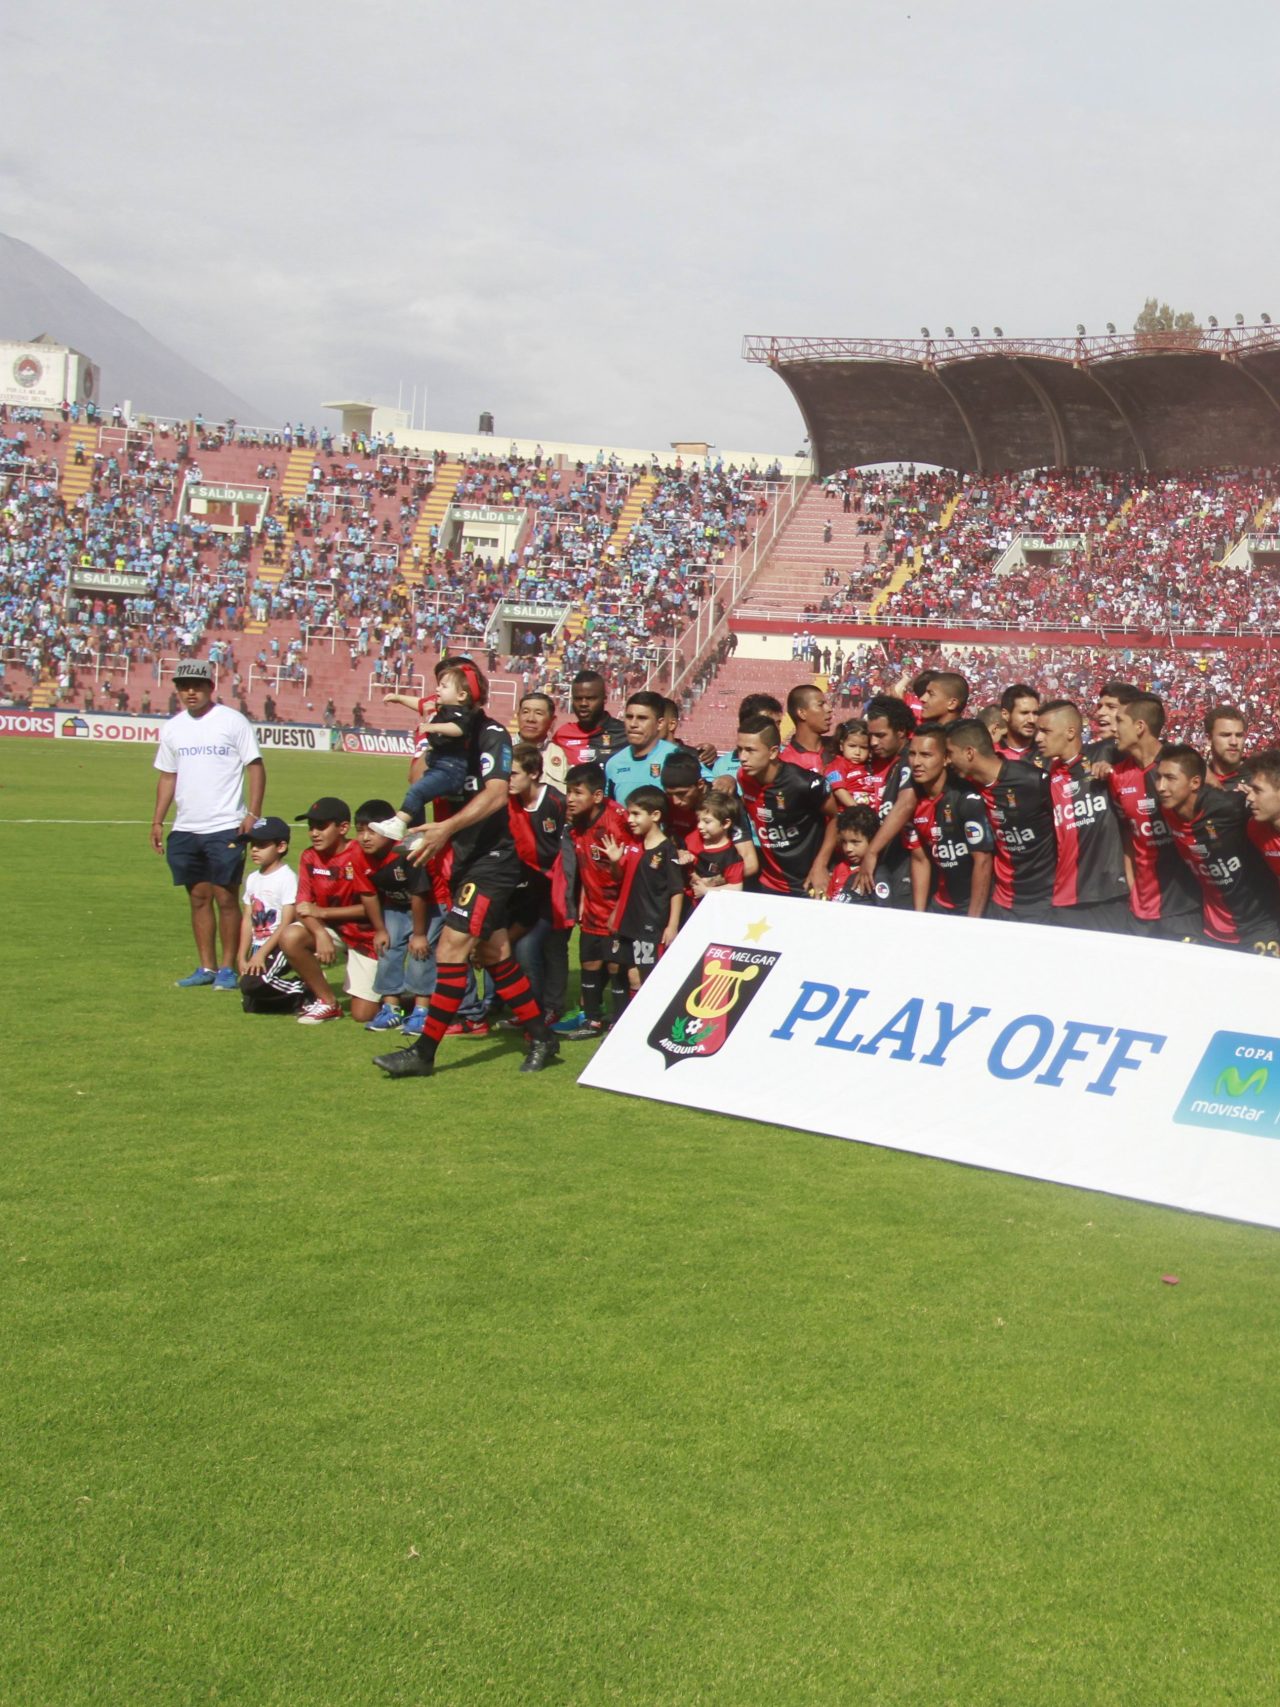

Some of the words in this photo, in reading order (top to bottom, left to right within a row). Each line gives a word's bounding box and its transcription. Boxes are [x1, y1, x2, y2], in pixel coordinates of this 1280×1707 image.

[199, 487, 245, 500] SALIDA
[463, 510, 505, 522] SALIDA
[83, 573, 130, 586] SALIDA
[513, 606, 553, 618] SALIDA
[177, 664, 208, 677] Mish
[178, 744, 230, 756] movistar
[360, 734, 416, 754] IDIOMAS
[1063, 793, 1107, 818] caja
[758, 825, 800, 841] caja
[995, 827, 1036, 845] caja
[931, 839, 969, 861] caja
[1198, 856, 1242, 878] caja
[458, 883, 477, 906] 9
[706, 947, 732, 960] FBC
[729, 950, 777, 967] MELGAR
[658, 1037, 707, 1055] AREQUIPA
[769, 980, 992, 1068] PLAY
[986, 1013, 1169, 1098] OFF
[1234, 1046, 1275, 1062] COPA
[1189, 1099, 1265, 1123] movistar
